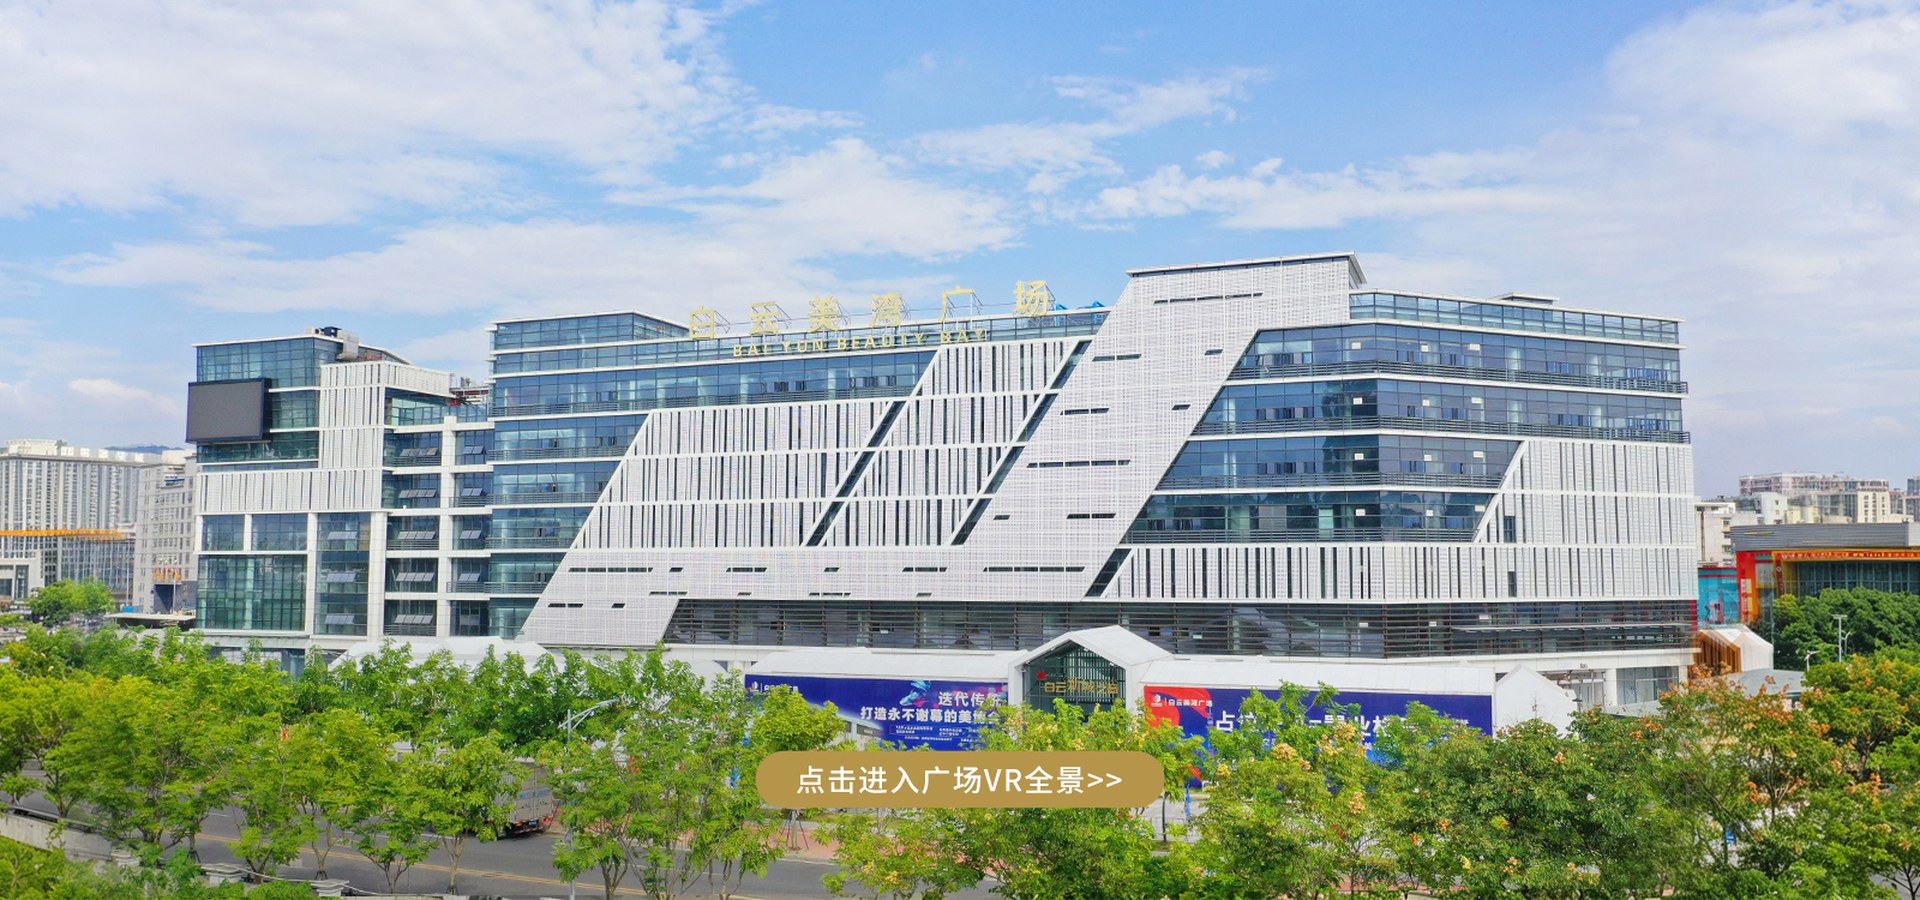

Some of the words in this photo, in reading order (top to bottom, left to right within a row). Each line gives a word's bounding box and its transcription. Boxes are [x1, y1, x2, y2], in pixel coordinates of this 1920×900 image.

[689, 280, 1050, 341] 白云美湾广场
[733, 343, 769, 358] BAI
[783, 339, 825, 353] YUN
[837, 333, 925, 351] BEAUTY
[940, 328, 986, 344] BAY
